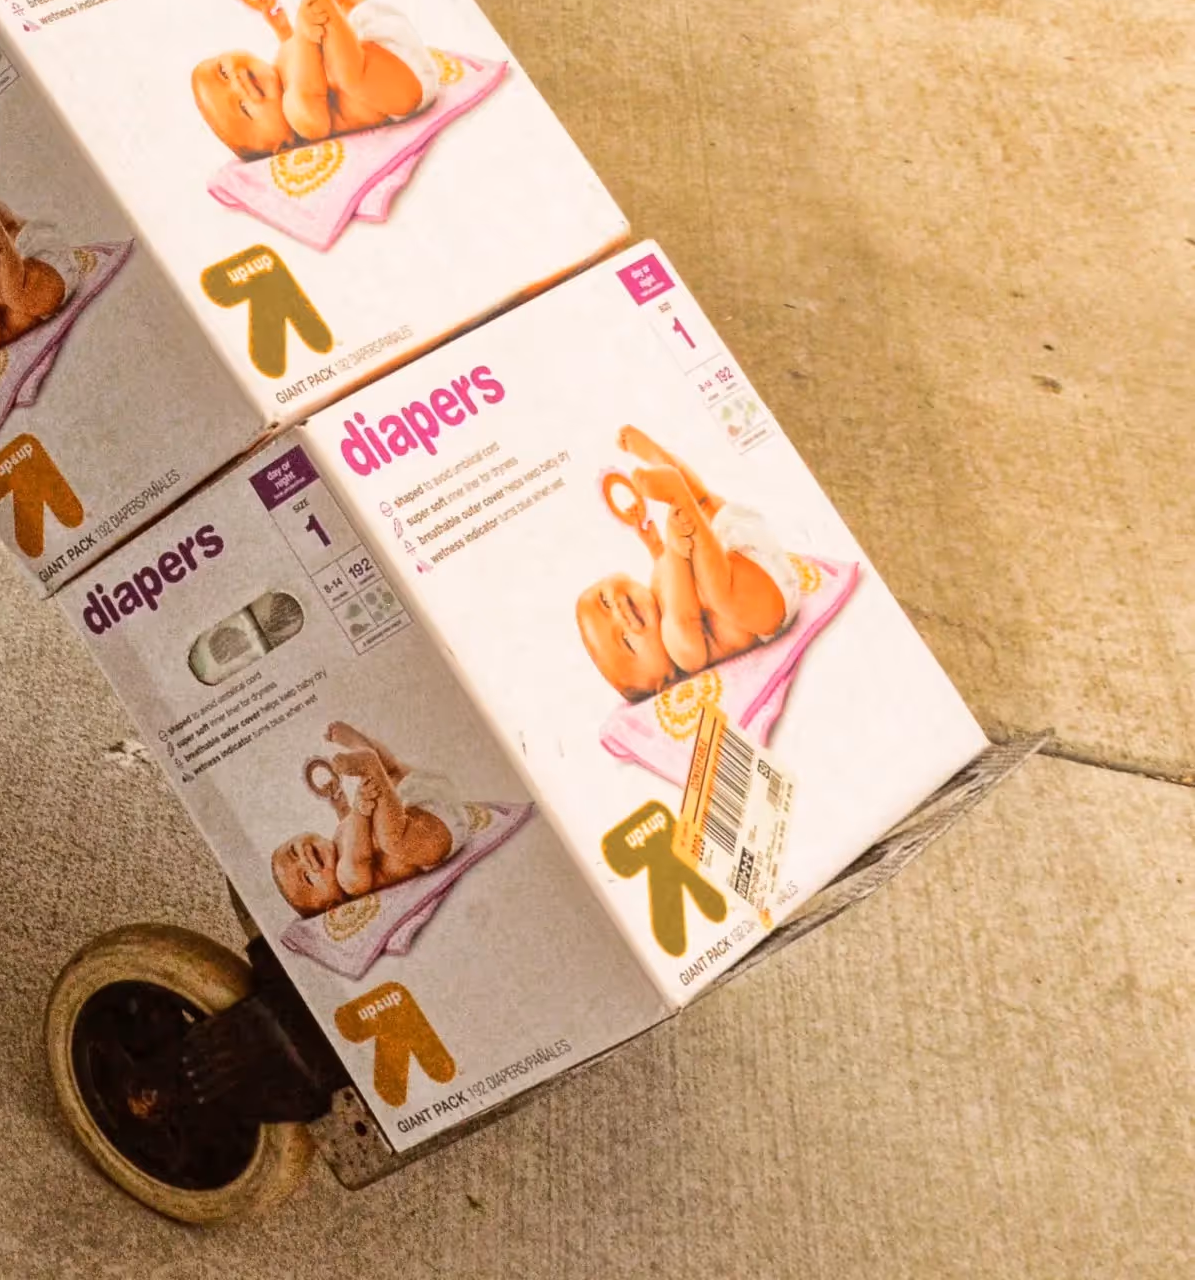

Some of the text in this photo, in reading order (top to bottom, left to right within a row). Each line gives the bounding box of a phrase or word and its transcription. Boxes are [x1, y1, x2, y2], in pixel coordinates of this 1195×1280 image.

[227, 254, 273, 283] up&up
[672, 317, 696, 349] 1
[275, 365, 337, 404] GIANT PACK
[714, 366, 734, 383] 192
[341, 366, 504, 475] diapers
[266, 459, 290, 481] day or
[274, 470, 296, 489] night
[291, 496, 310, 513] SIZE
[305, 513, 331, 547] 1
[37, 554, 67, 584] GIANT
[66, 533, 97, 561] PACK
[94, 520, 113, 539] 192
[83, 525, 223, 634] diapers
[323, 556, 374, 594] 8-14 192
[625, 811, 666, 847] up&up
[679, 955, 708, 986] GIANT
[705, 936, 733, 964] PACK
[358, 990, 402, 1020] up&up
[396, 1038, 571, 1133] GIANT PACK 192 DIAPERS/PAÑALES
